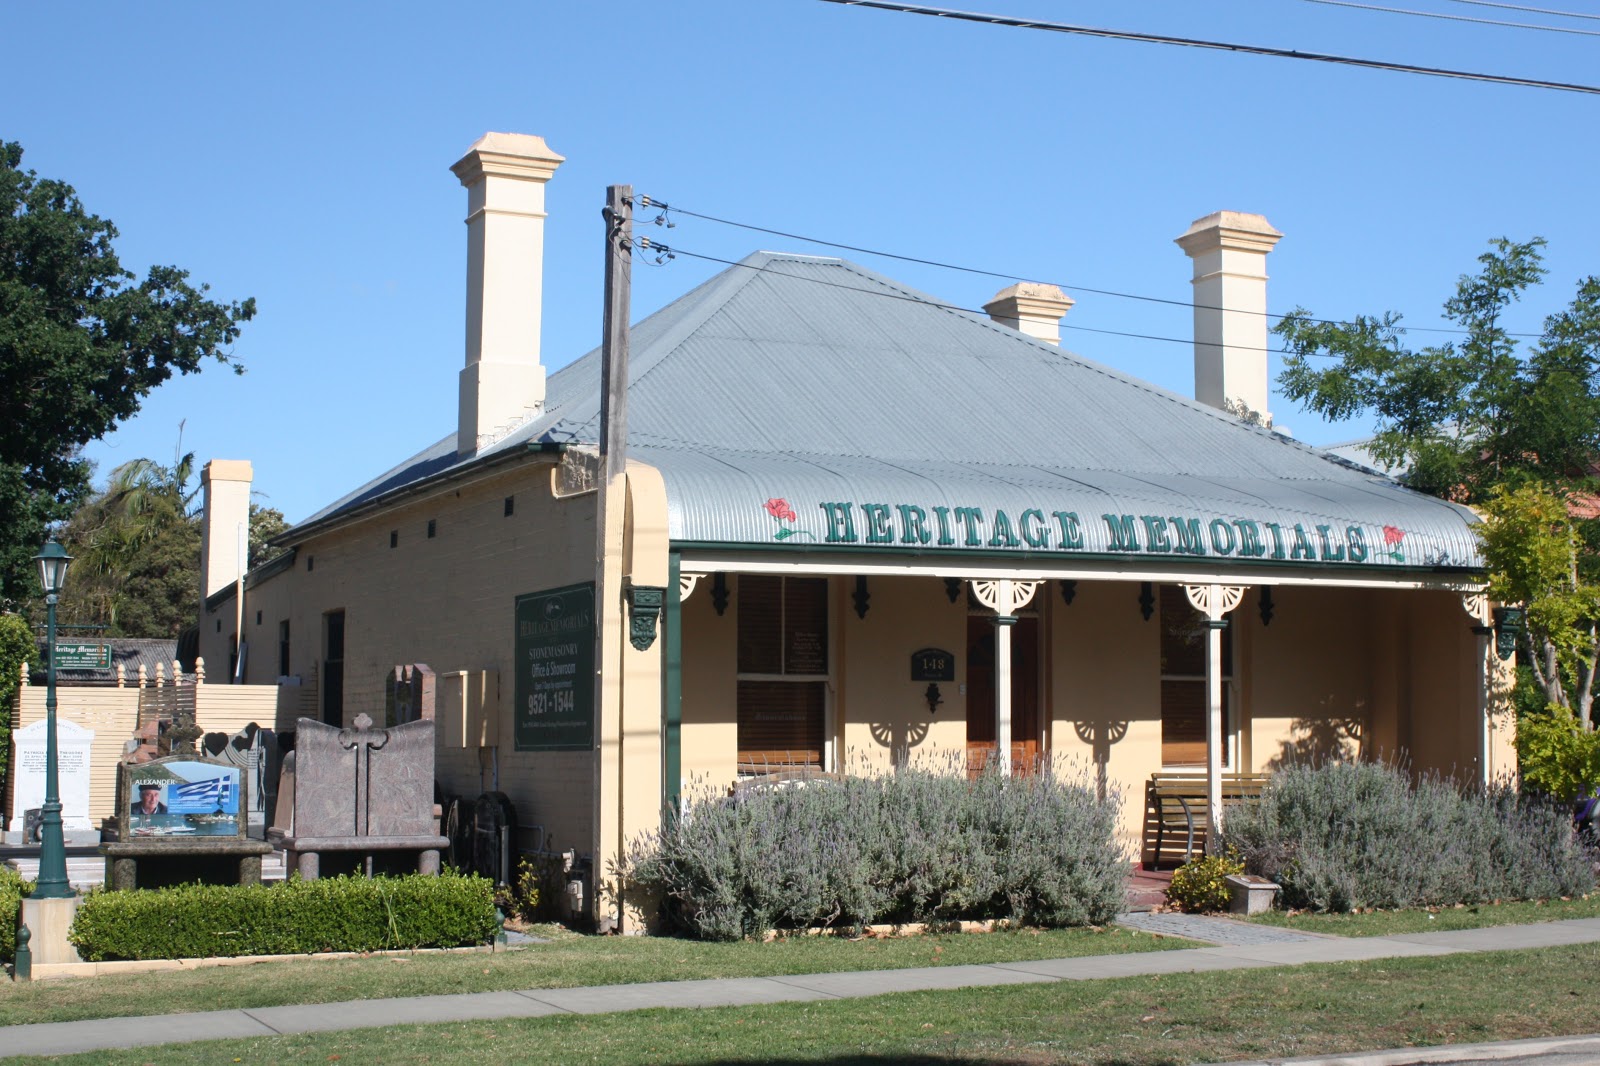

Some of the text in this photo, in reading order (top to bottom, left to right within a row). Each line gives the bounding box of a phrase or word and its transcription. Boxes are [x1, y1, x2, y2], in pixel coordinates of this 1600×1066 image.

[820, 501, 1368, 563] HERITAGE MEMORIALS
[529, 643, 578, 660] STONEMASONRY
[531, 664, 545, 678] Office
[550, 661, 576, 676] Showroom
